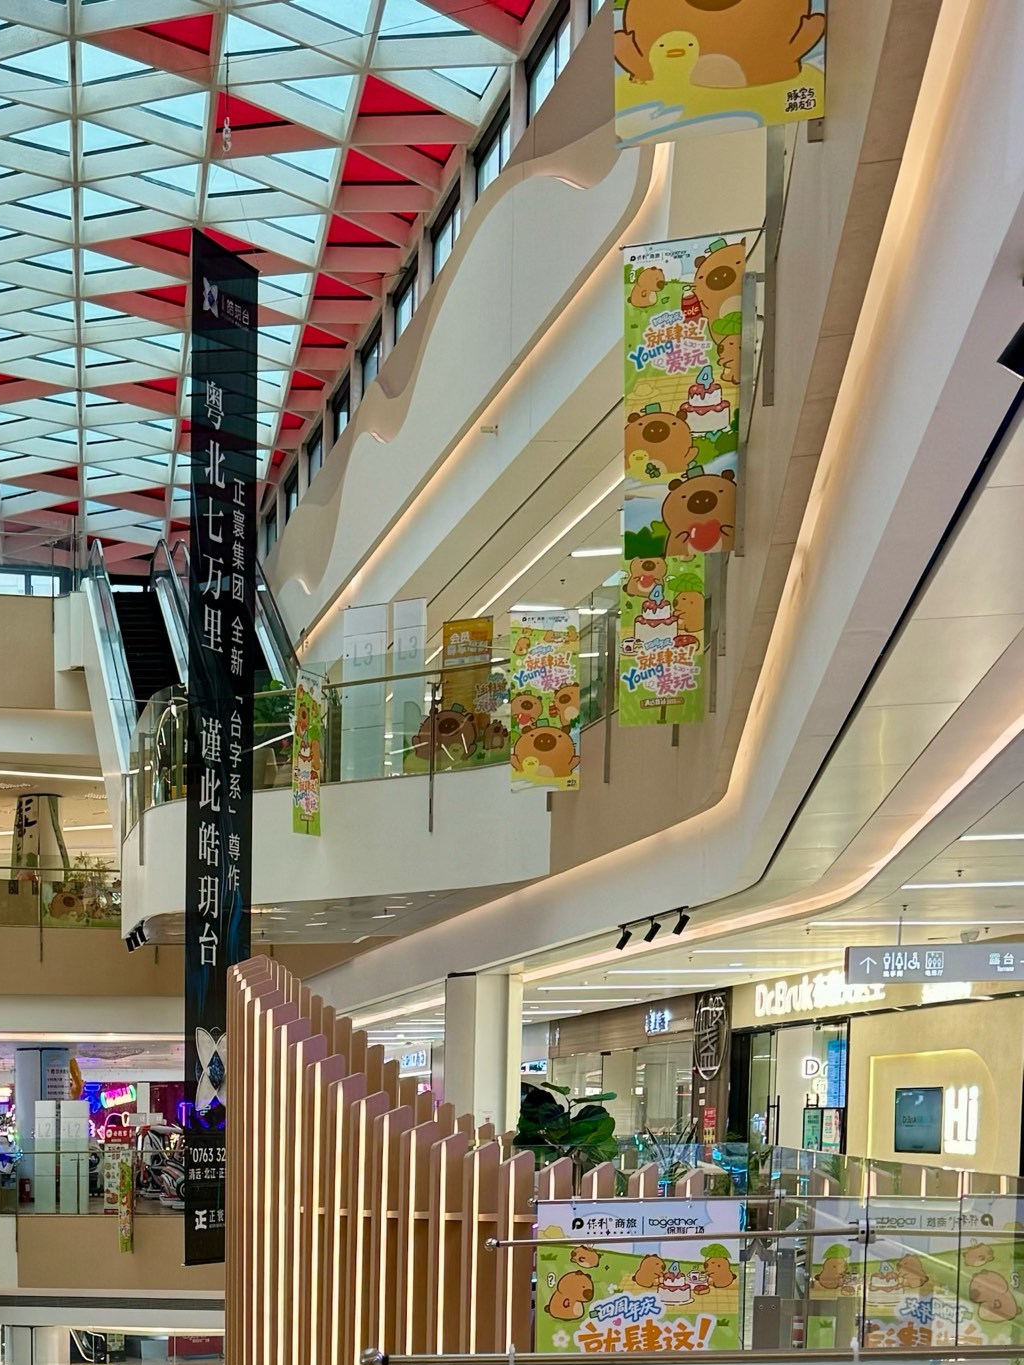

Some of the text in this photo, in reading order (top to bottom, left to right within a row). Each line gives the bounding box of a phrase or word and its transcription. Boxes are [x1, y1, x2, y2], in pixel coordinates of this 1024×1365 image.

[629, 341, 674, 370] Young
[202, 380, 225, 653] 粤北七万里
[230, 616, 244, 677] 全新
[352, 641, 373, 667] L3
[397, 636, 418, 661] L3
[514, 667, 547, 687] Young
[623, 665, 663, 690] Young
[227, 833, 241, 891] 尊作
[38, 1122, 52, 1138] L2
[649, 1218, 698, 1228] together
